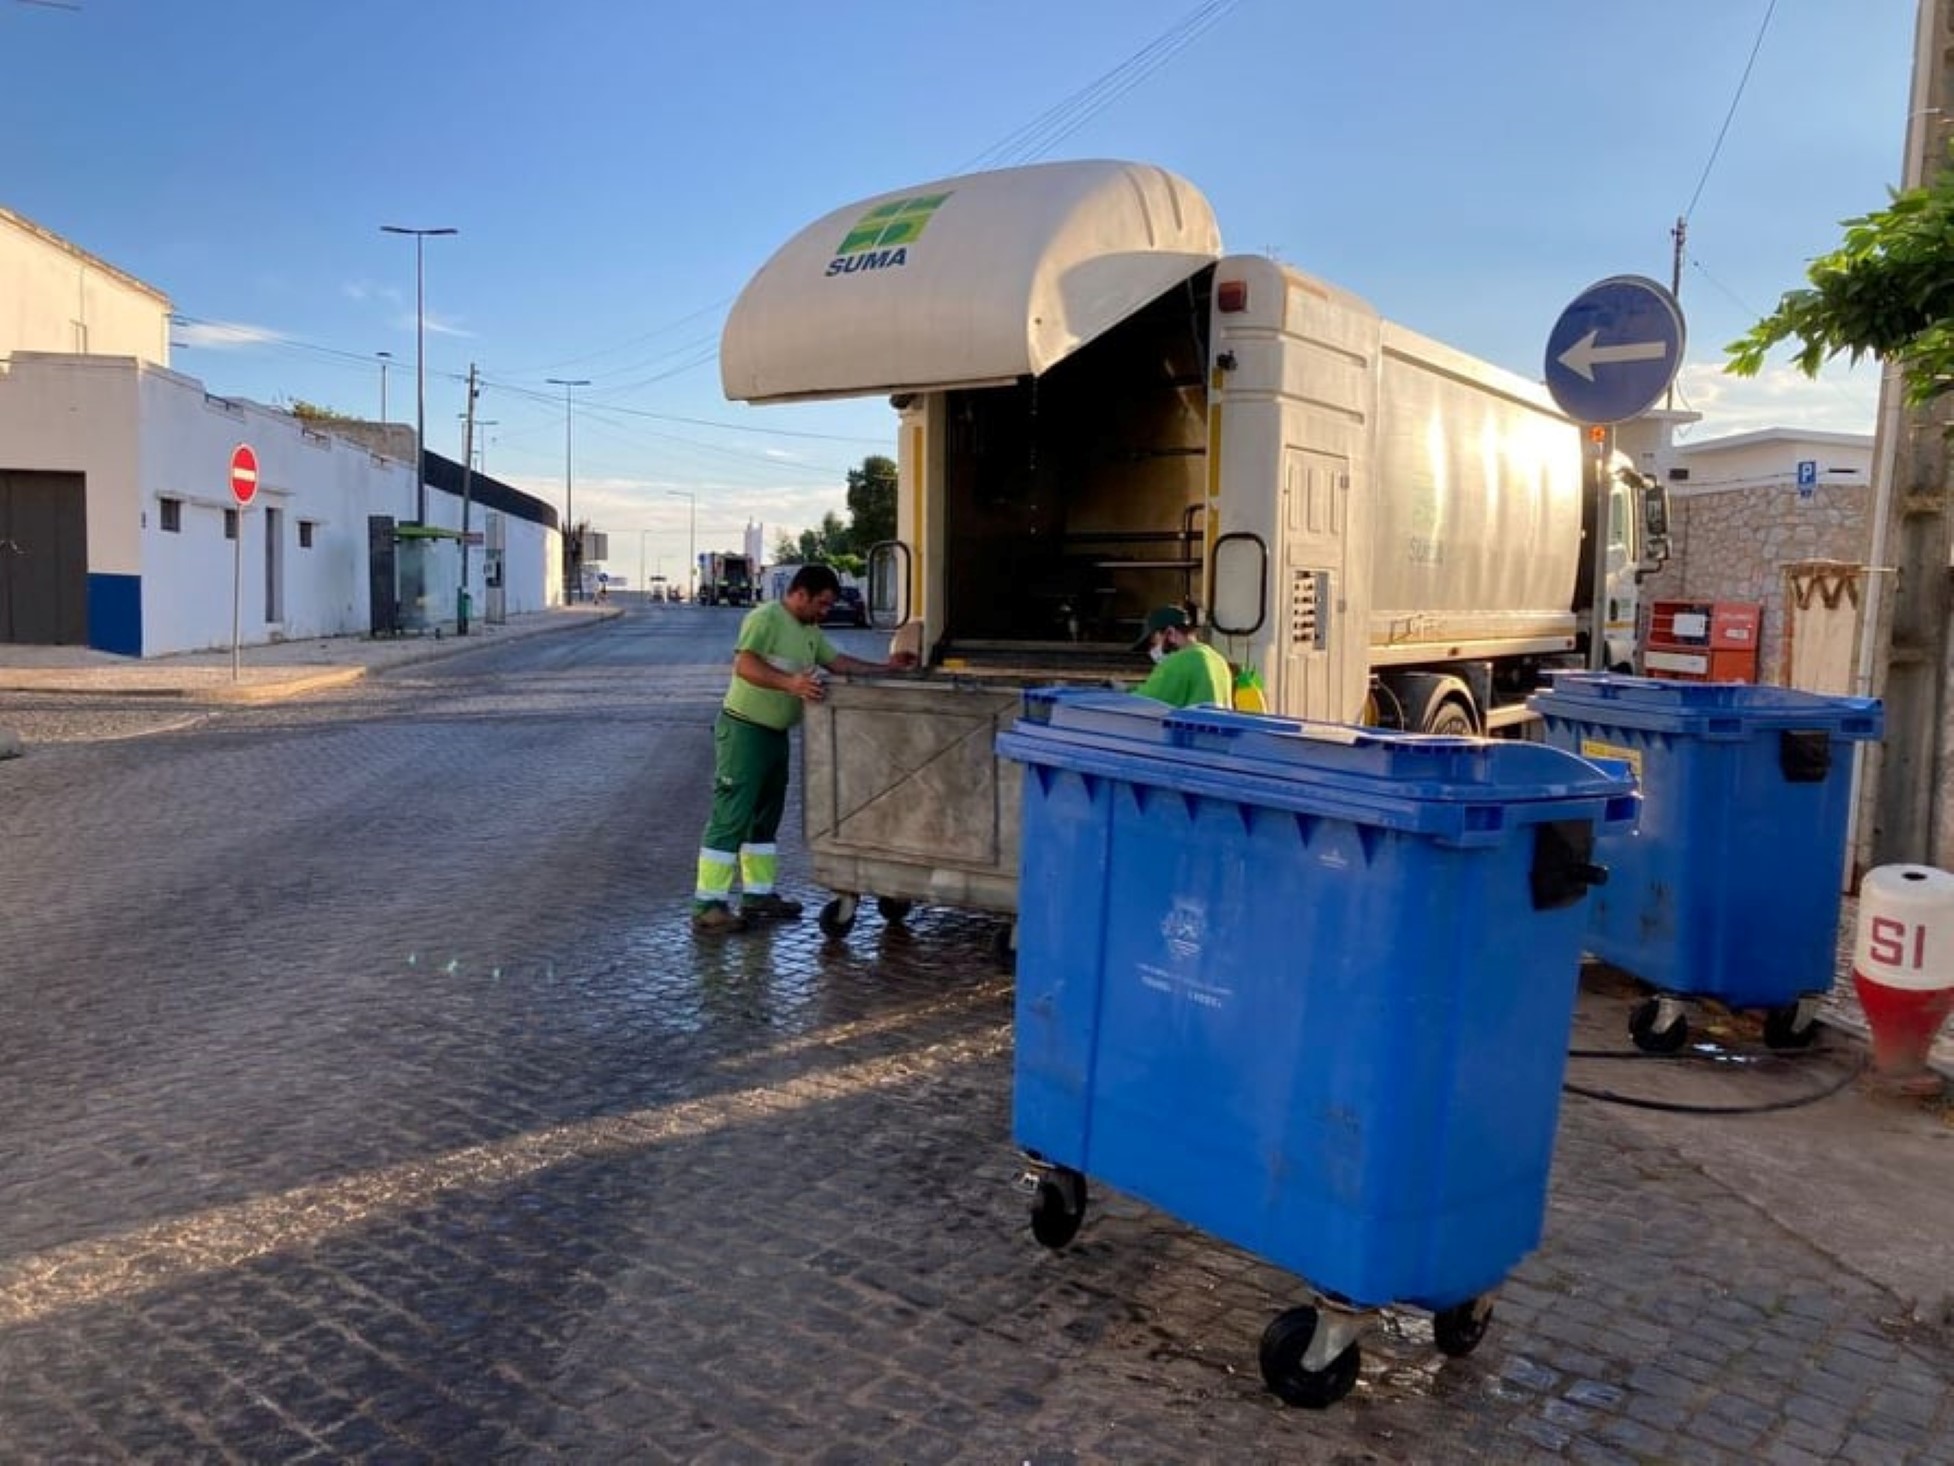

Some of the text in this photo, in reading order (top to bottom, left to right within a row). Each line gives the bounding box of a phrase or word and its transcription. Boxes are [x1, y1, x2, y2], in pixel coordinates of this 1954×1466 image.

[825, 248, 907, 277] SUMA
[1802, 463, 1813, 483] P
[1870, 915, 1926, 970] SI
